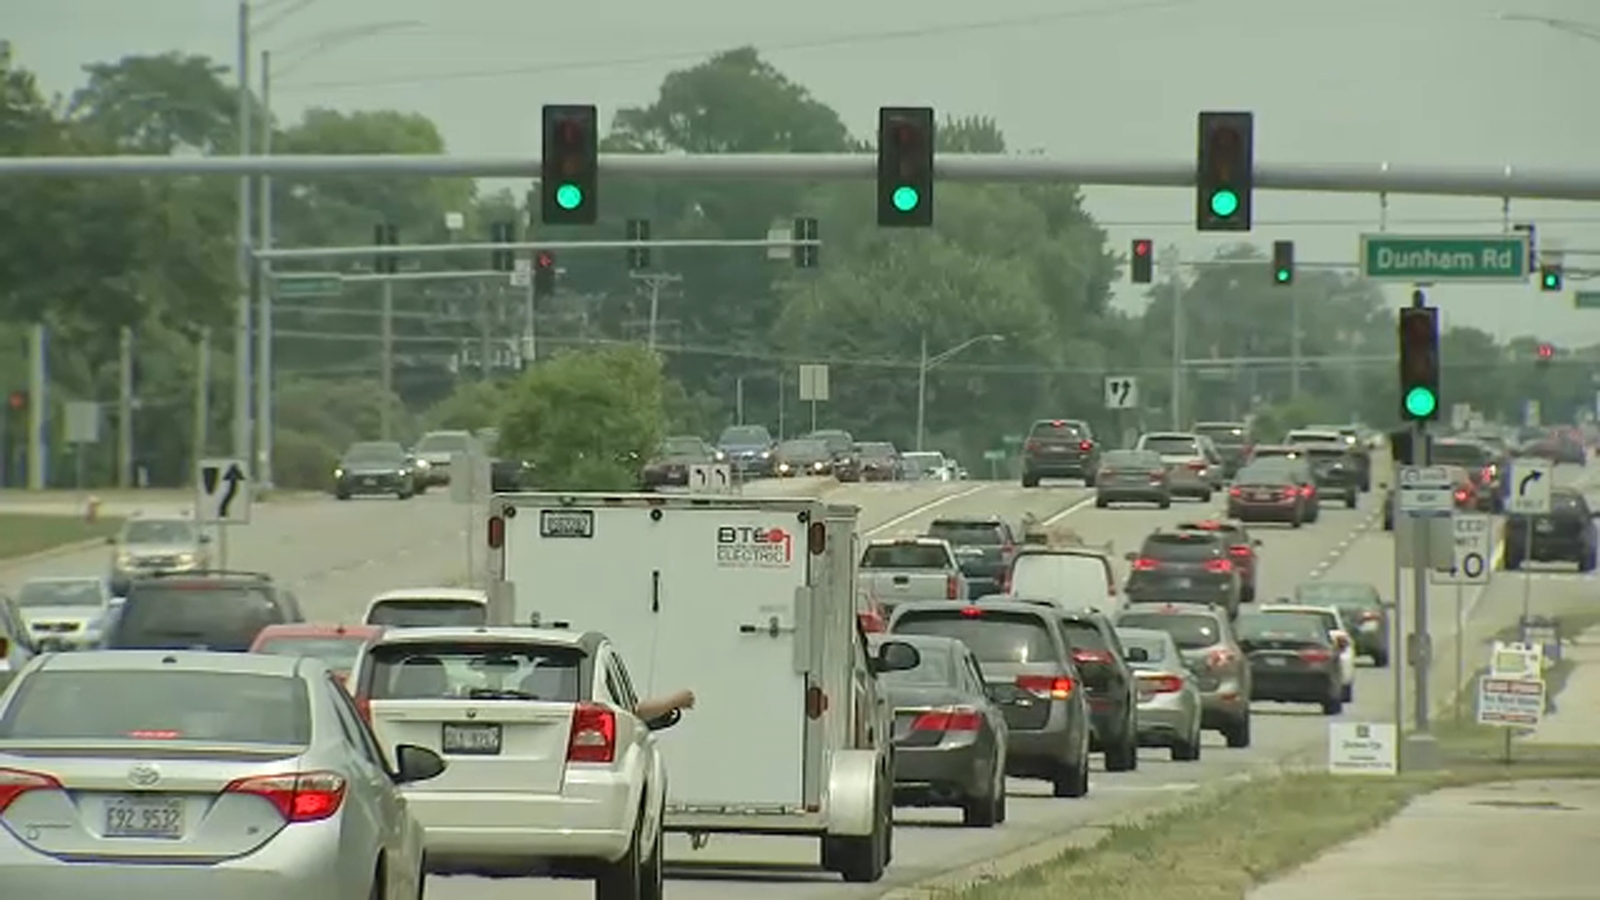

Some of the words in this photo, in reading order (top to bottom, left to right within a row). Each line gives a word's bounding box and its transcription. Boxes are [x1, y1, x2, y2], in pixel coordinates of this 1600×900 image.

[1376, 247, 1474, 269] Dunham
[1482, 247, 1512, 269] Rd
[717, 550, 783, 562] ELECTRIC
